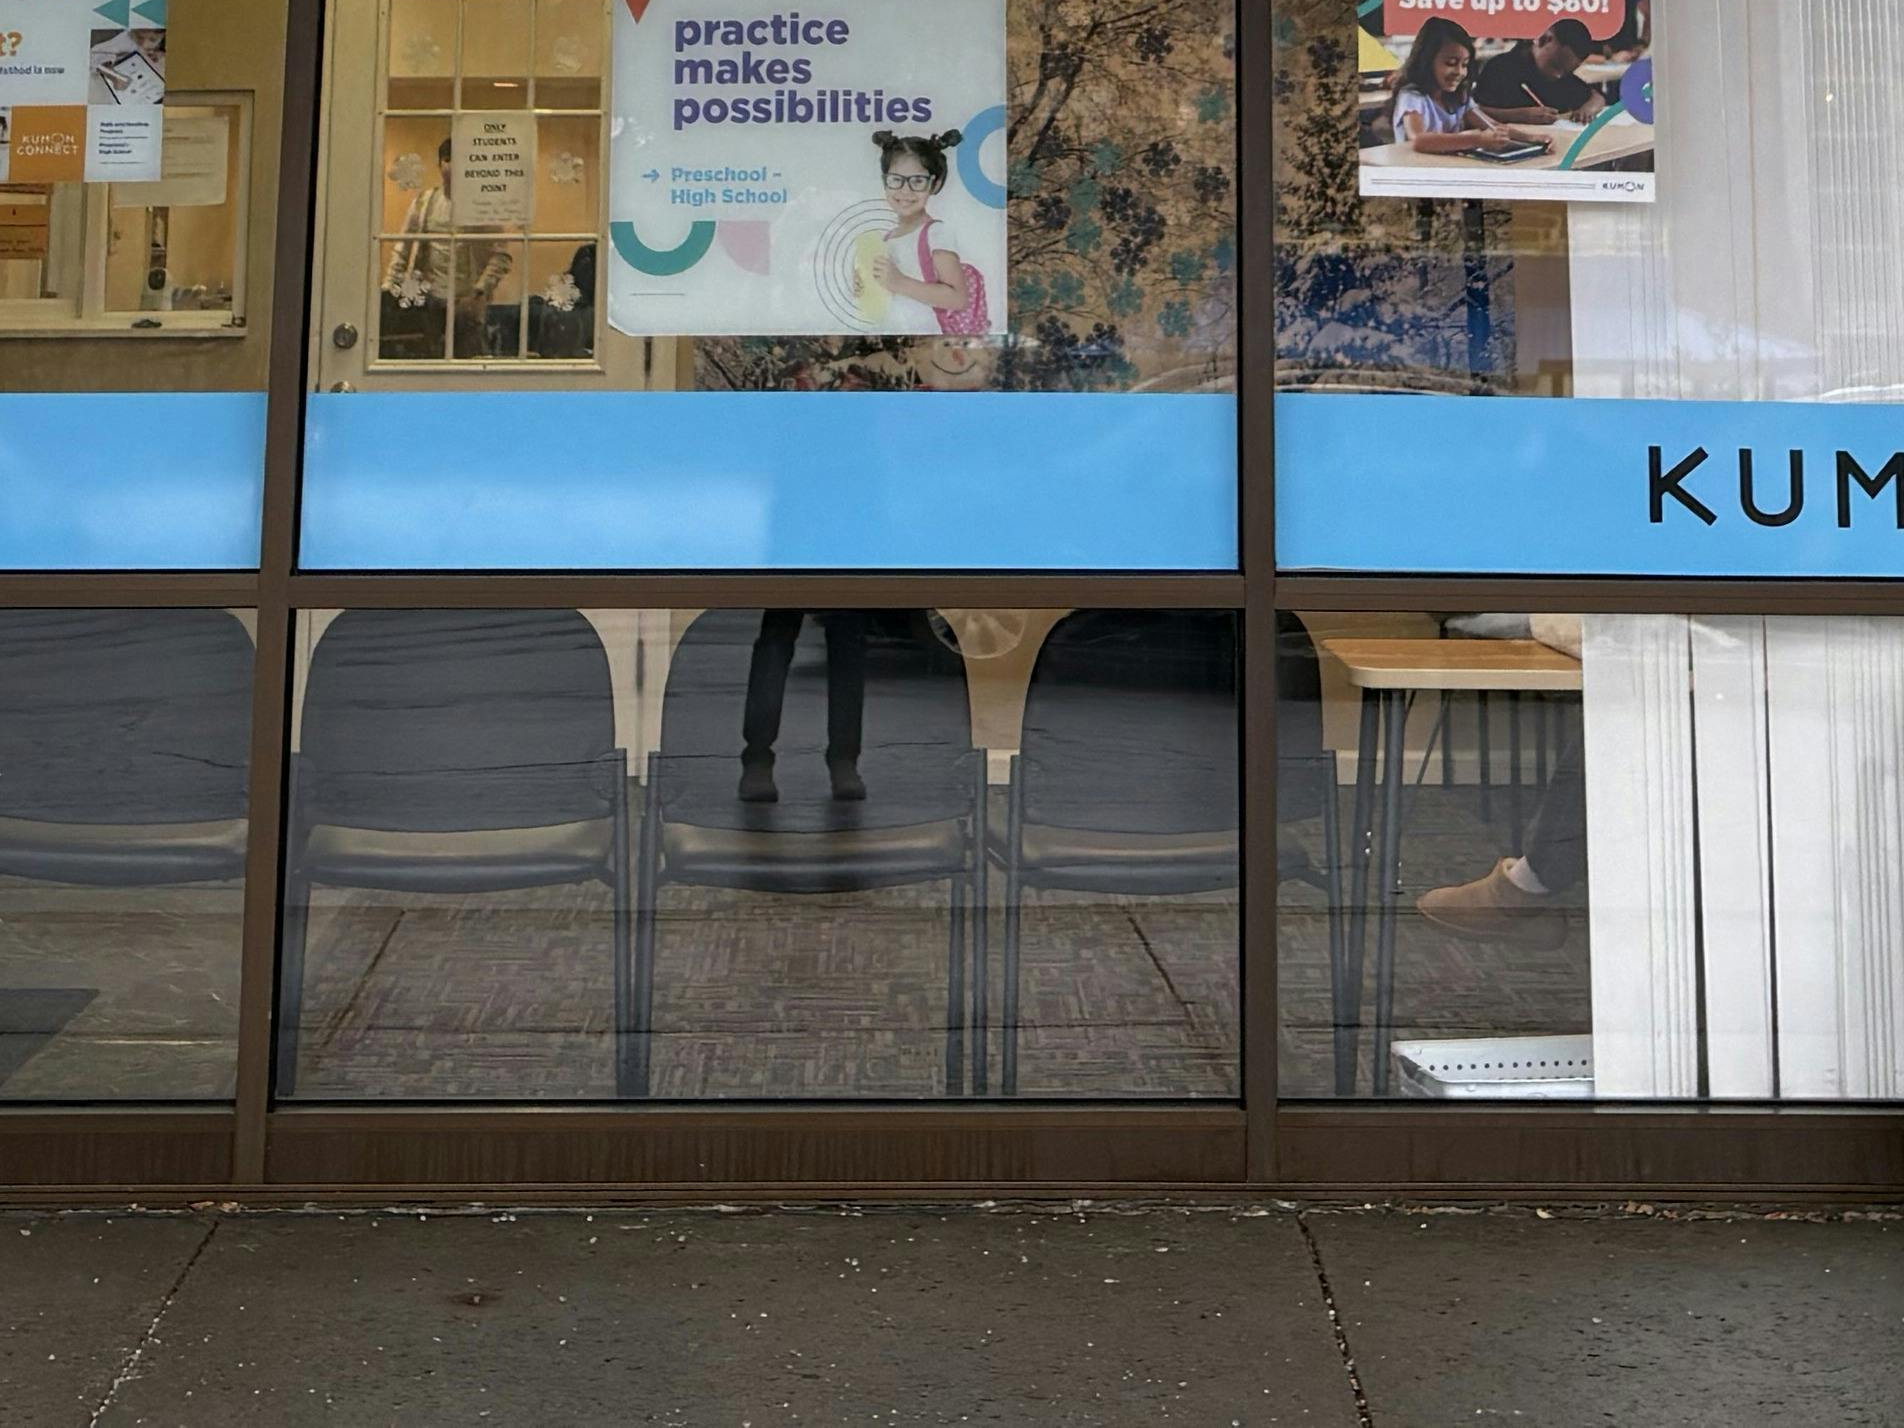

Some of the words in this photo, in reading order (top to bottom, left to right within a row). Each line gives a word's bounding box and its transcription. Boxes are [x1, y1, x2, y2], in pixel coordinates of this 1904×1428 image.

[675, 12, 849, 52] practice
[674, 51, 812, 85] makes
[674, 90, 932, 130] possibilities
[671, 167, 767, 182] Preschool
[671, 189, 716, 206] High
[721, 189, 788, 204] School
